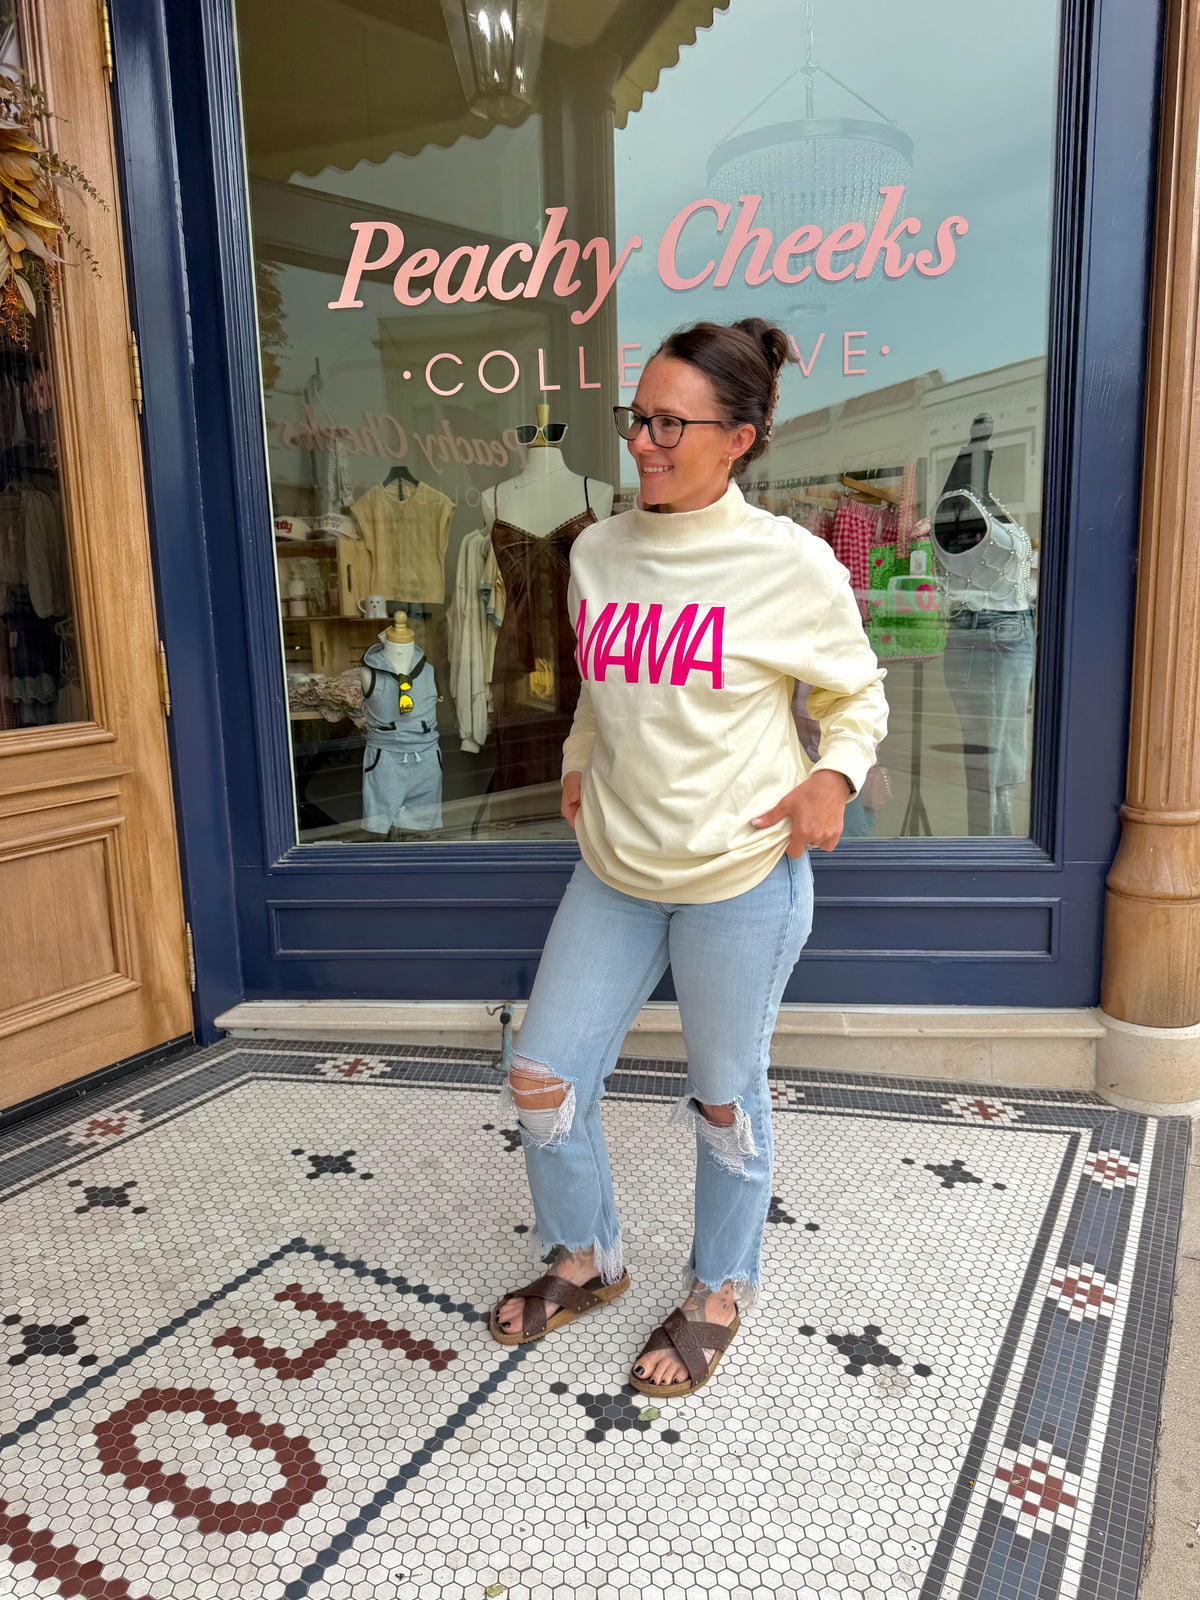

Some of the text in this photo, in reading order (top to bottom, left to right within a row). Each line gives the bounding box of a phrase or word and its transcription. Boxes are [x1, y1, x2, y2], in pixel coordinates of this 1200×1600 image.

[328, 184, 969, 325] Peachy Cheeks
[425, 331, 868, 396] COLLEVE
[574, 598, 725, 690] MAMA
